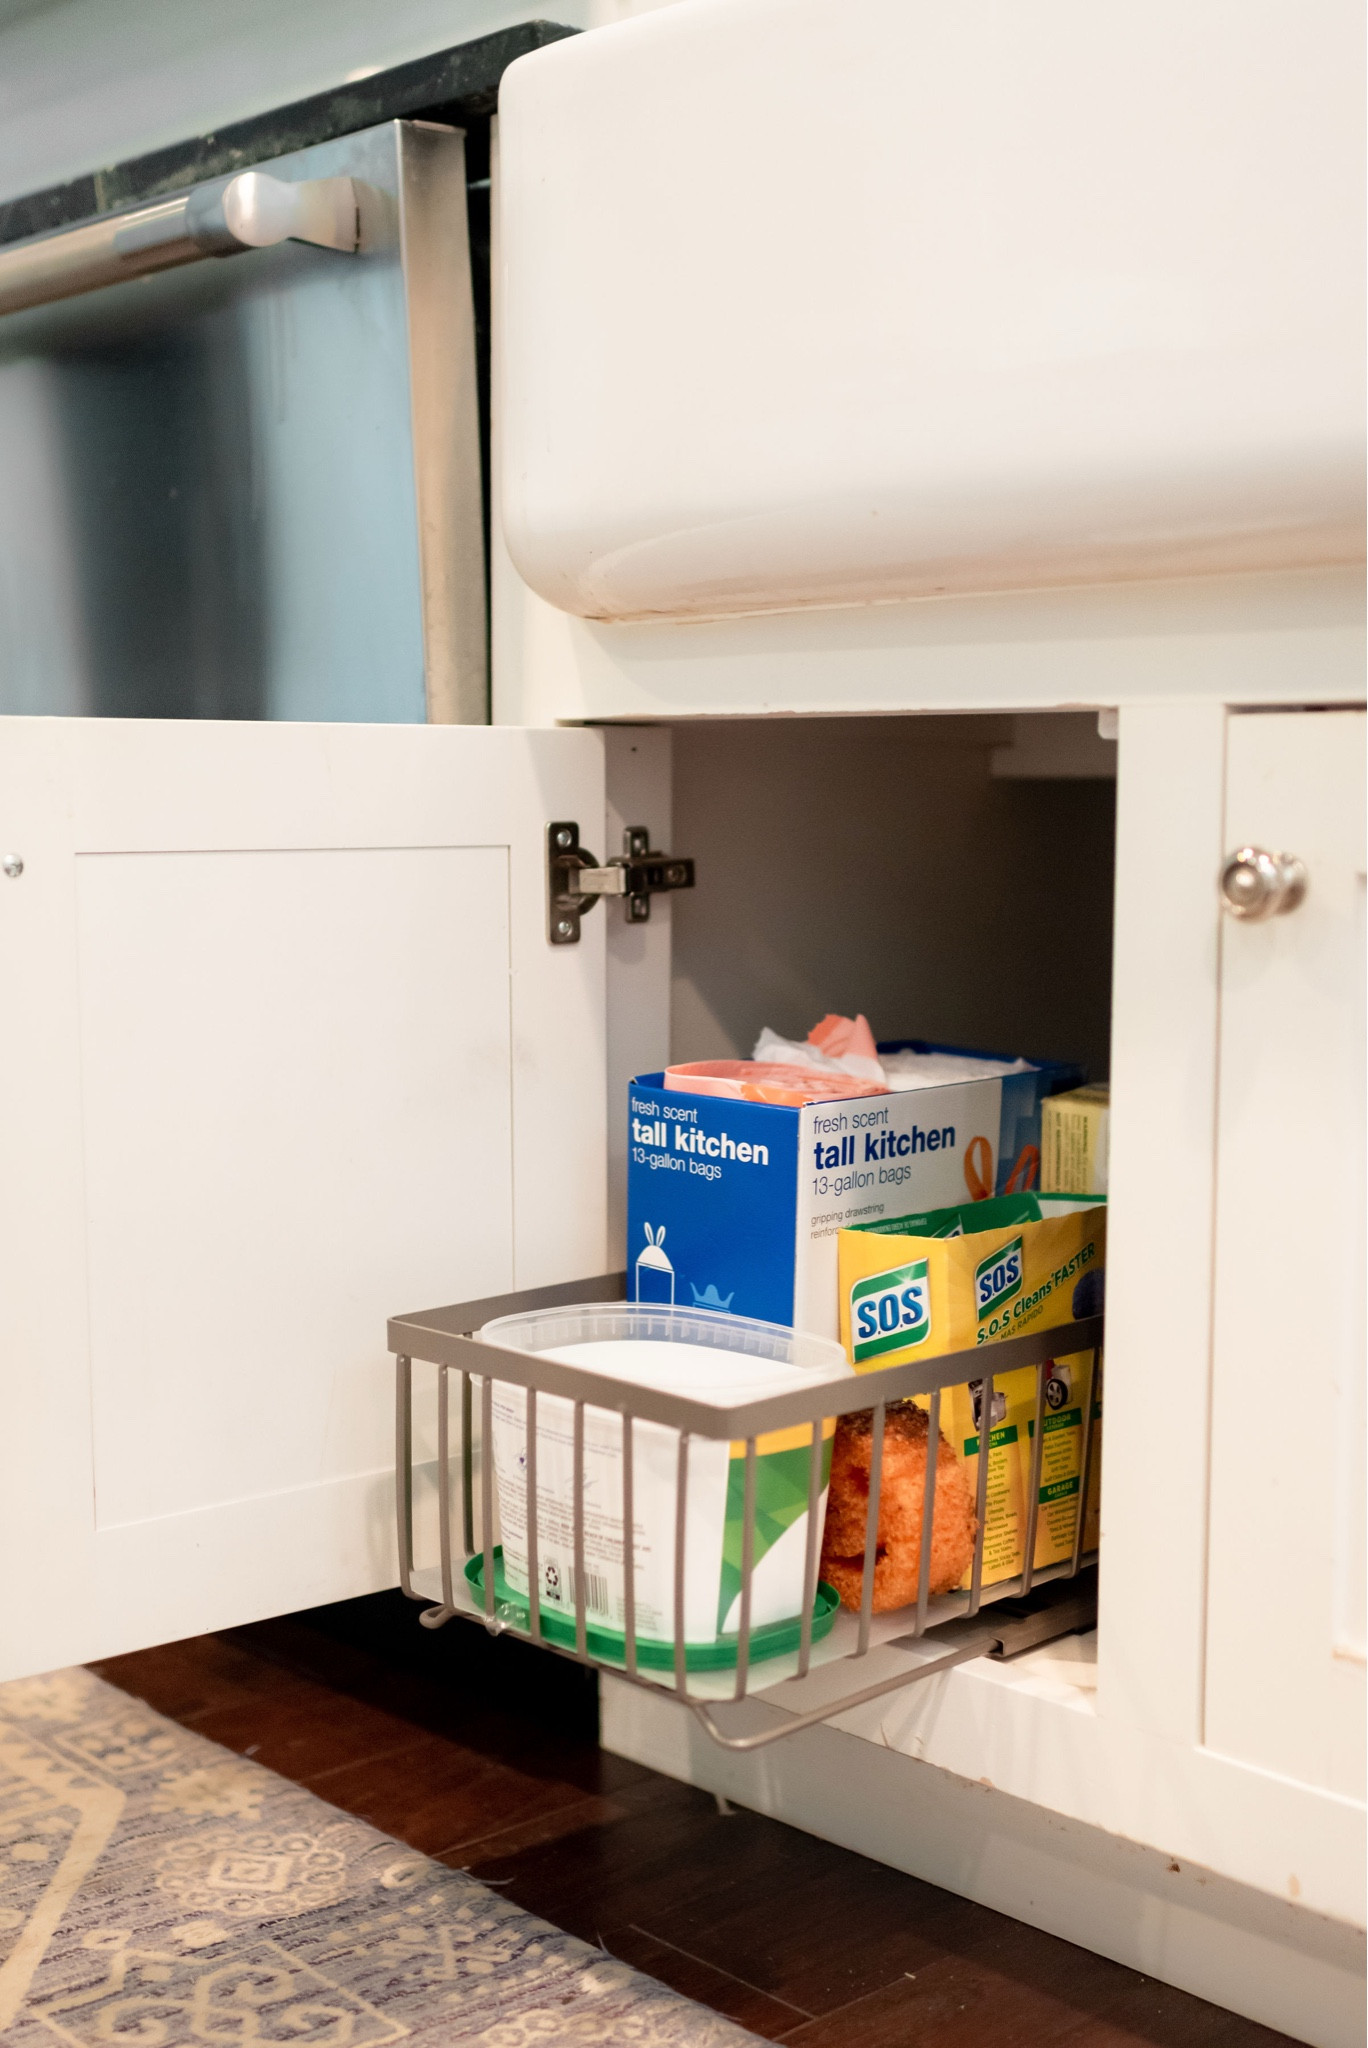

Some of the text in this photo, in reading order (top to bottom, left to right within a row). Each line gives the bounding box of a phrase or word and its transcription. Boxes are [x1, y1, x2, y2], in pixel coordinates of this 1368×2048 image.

[631, 1097, 698, 1123] fresh scent
[813, 1106, 889, 1135] fresh scent
[632, 1118, 769, 1166] tall kitchen
[814, 1125, 956, 1170] tall kitchen
[632, 1147, 722, 1181] 13-gallon bags
[811, 1163, 912, 1197] 13-gallon bags
[811, 1203, 885, 1227] gripping drawstring
[1013, 1281, 1052, 1318] Cleans
[1047, 1481, 1073, 1496] GARAGE
